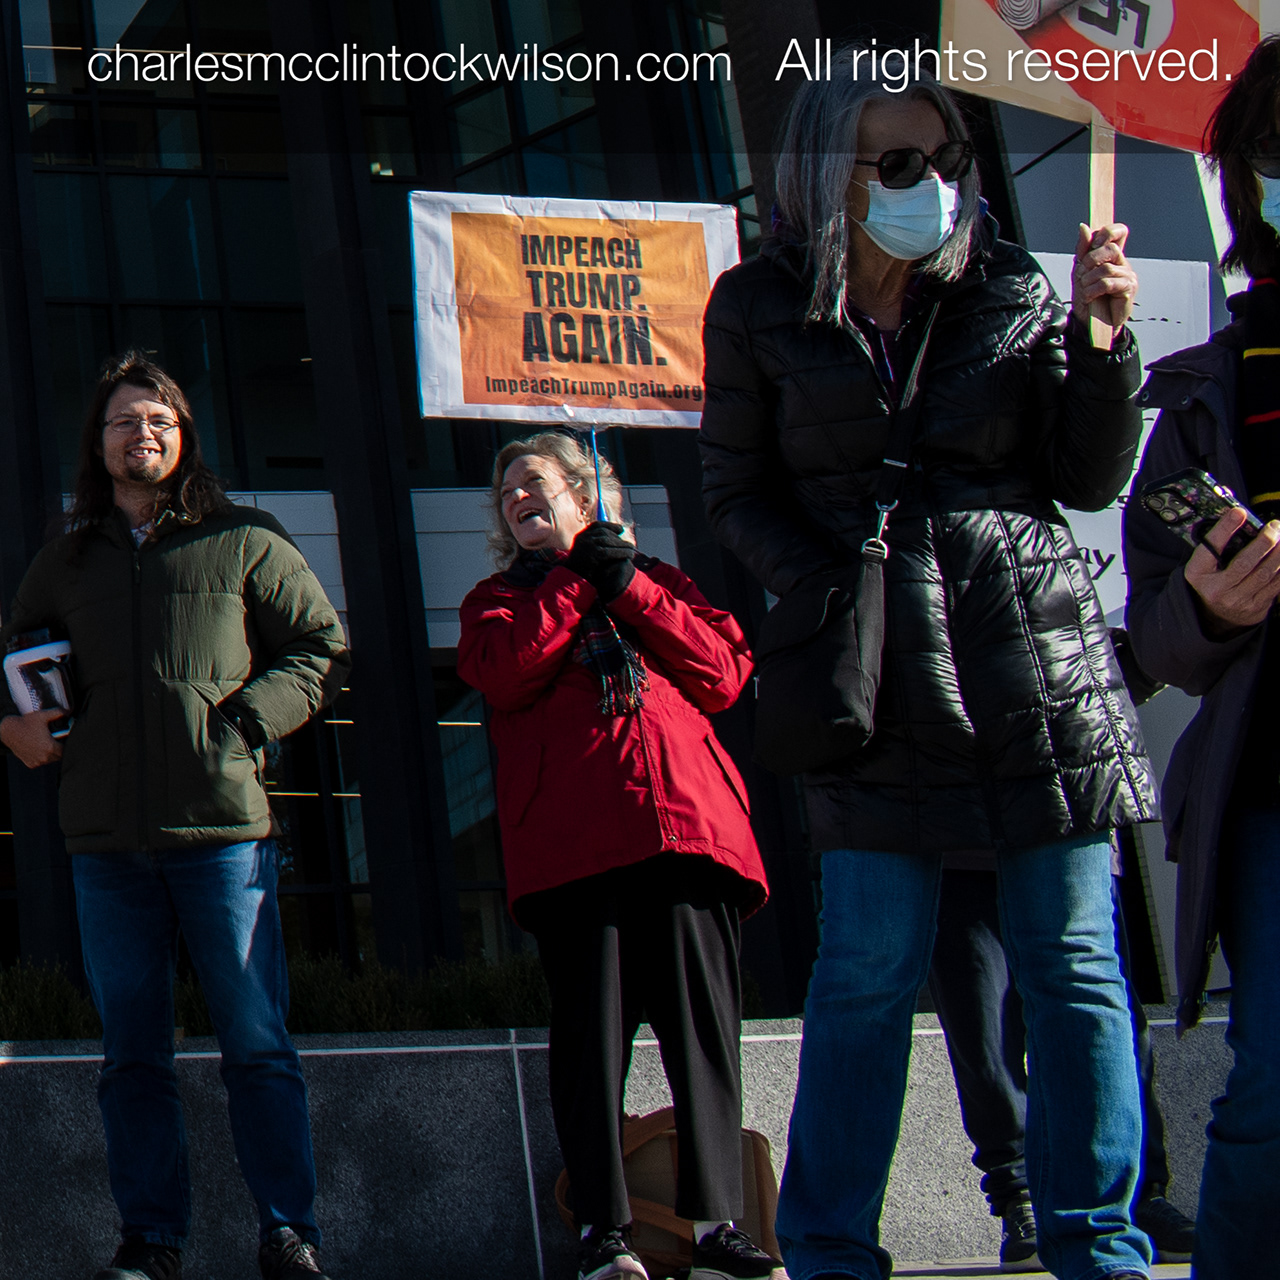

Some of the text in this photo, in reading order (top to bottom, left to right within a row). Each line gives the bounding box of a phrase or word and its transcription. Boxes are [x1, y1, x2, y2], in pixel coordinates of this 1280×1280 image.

[521, 234, 643, 269] IMPEACH
[526, 270, 648, 311] TRUMP.
[522, 311, 668, 366] AGAIN.
[485, 375, 703, 402] ImpeachTrumpAgain.org
